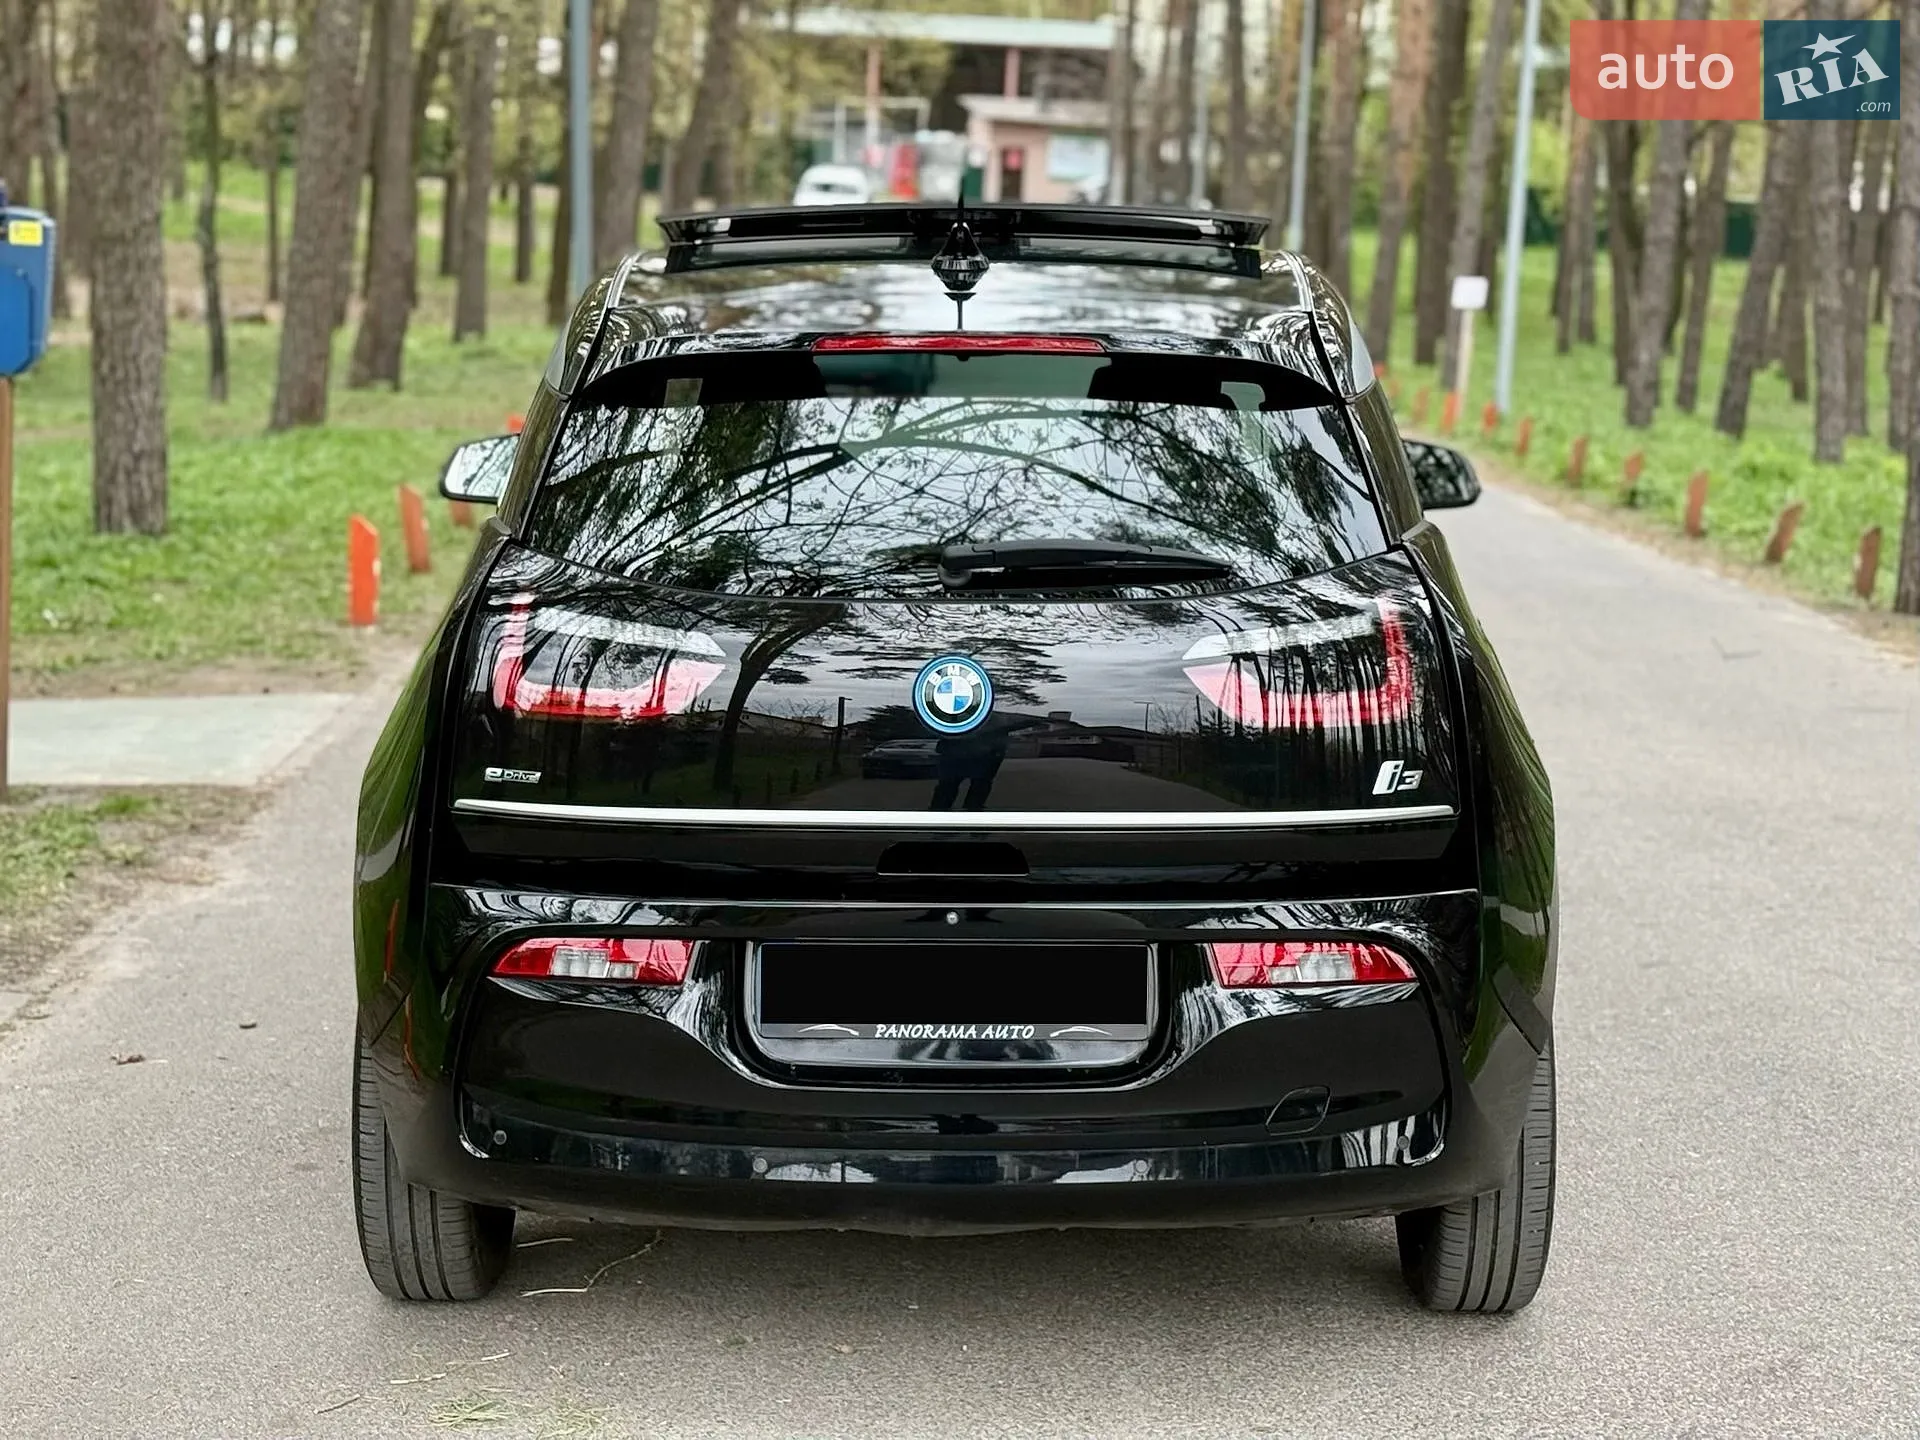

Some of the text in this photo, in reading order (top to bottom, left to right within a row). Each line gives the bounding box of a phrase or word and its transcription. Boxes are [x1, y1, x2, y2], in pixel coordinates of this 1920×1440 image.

[1372, 760, 1423, 795] i3
[874, 1024, 1035, 1039] PANORAMA AUTO
